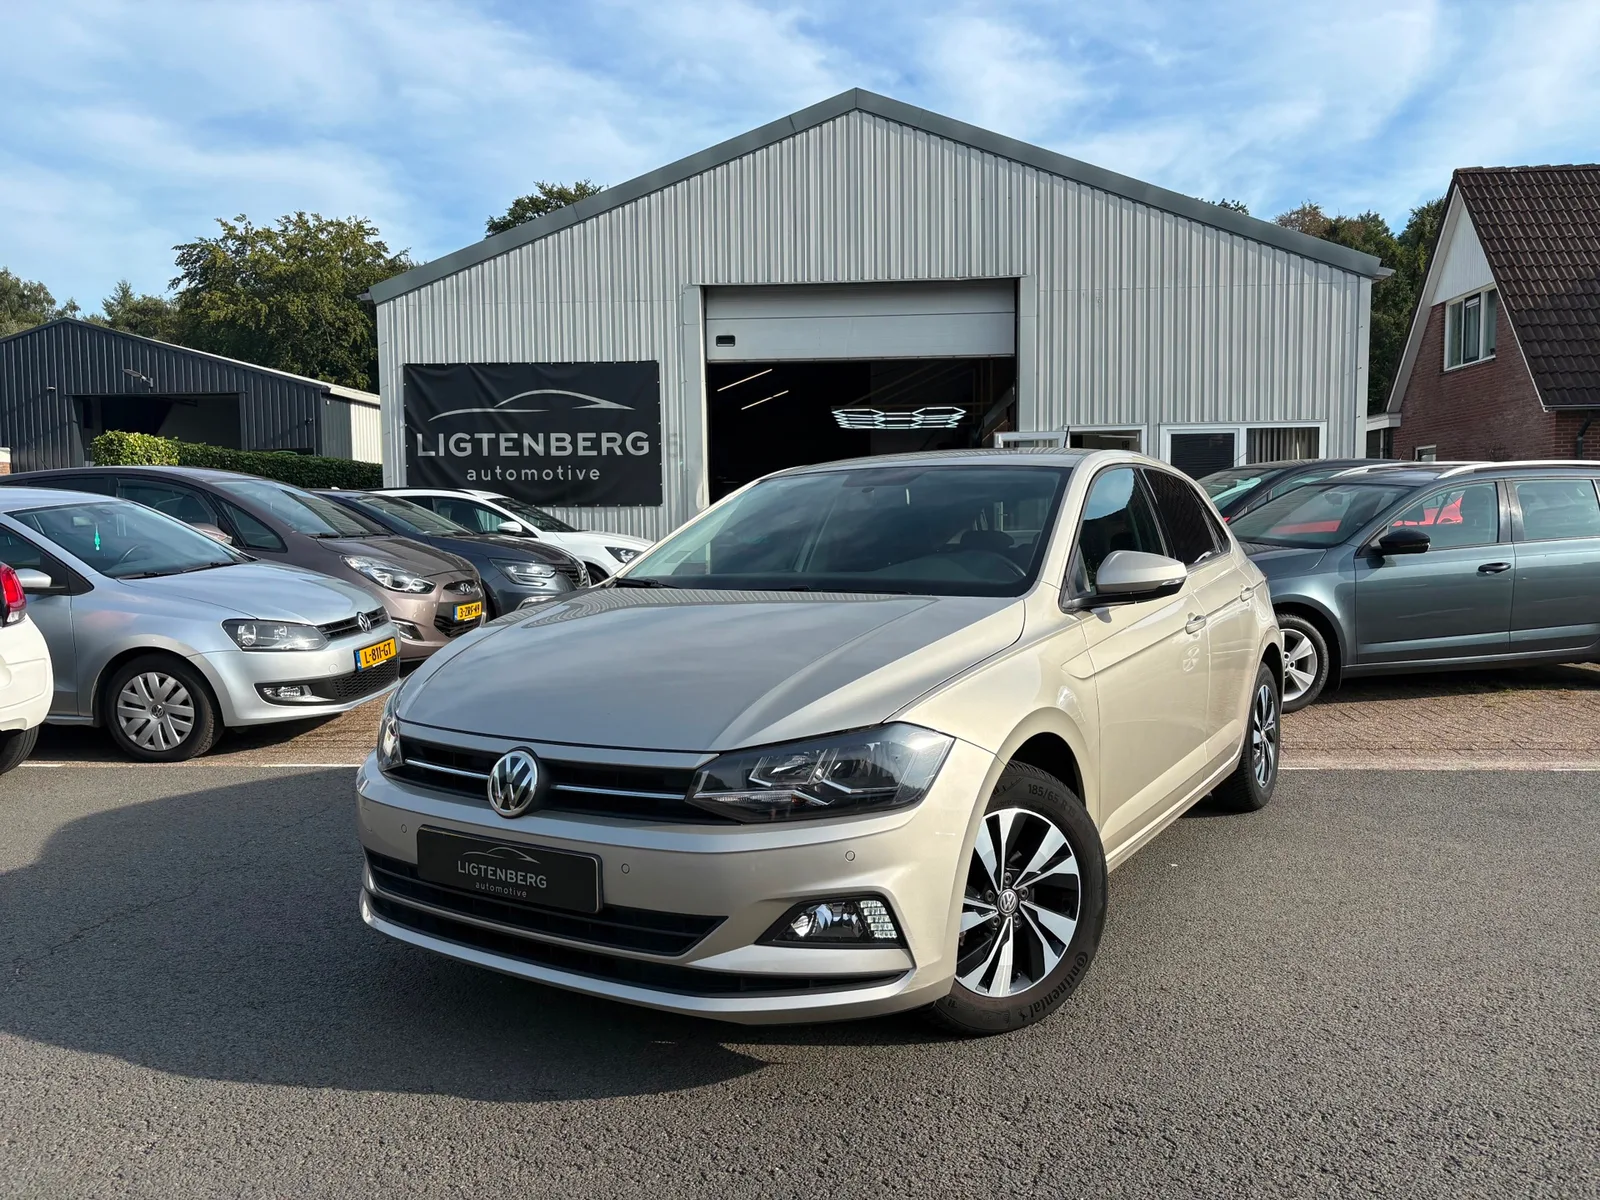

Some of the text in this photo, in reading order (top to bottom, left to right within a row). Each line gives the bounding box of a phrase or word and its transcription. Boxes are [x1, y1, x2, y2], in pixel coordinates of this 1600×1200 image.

[416, 431, 650, 457] LIGTENBERG
[466, 465, 600, 481] automotive
[364, 642, 392, 664] L-811-GT
[1027, 783, 1060, 804] 185/65
[457, 860, 547, 889] LIGTENBERG
[475, 881, 527, 898] automotive
[1029, 951, 1089, 1021] Continental
